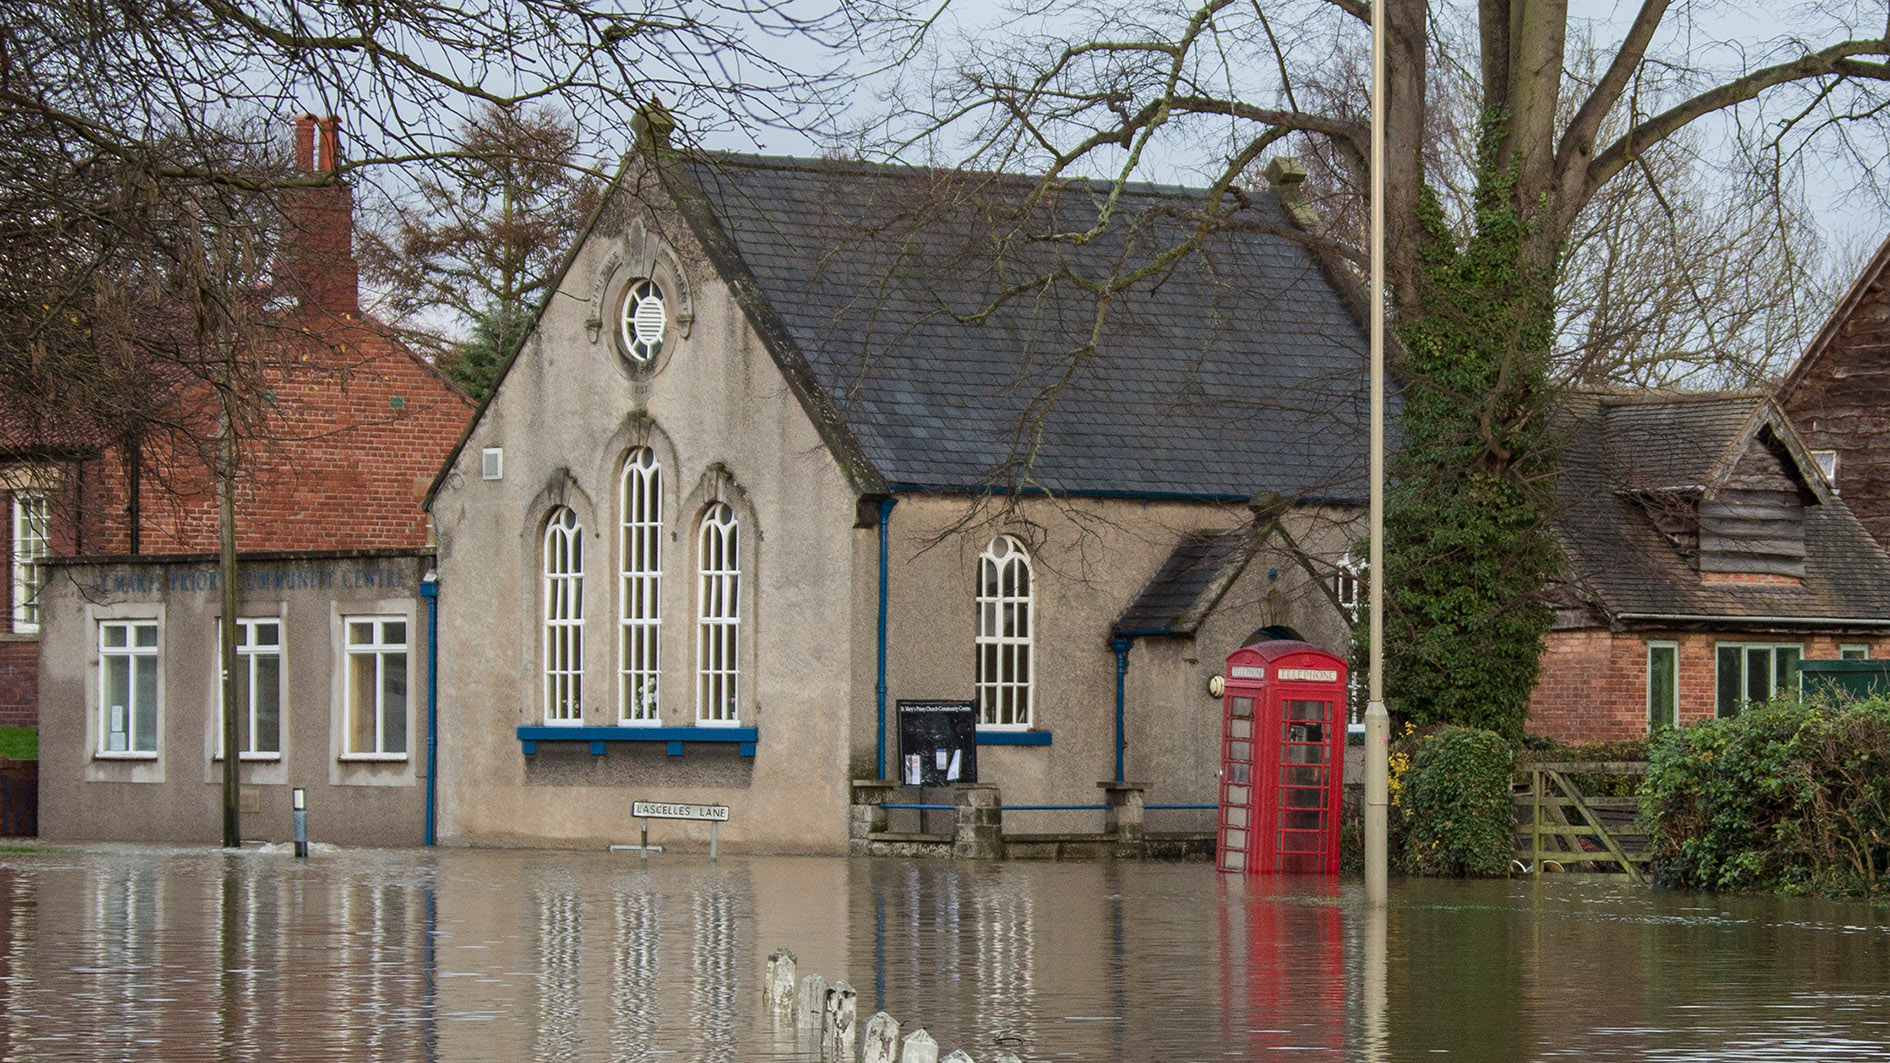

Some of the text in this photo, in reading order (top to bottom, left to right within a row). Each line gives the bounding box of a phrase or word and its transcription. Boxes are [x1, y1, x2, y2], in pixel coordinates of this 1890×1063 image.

[341, 567, 404, 588] CENTRE
[1281, 669, 1335, 680] TELEPHONE
[636, 804, 726, 818] LASCELLES LANE
